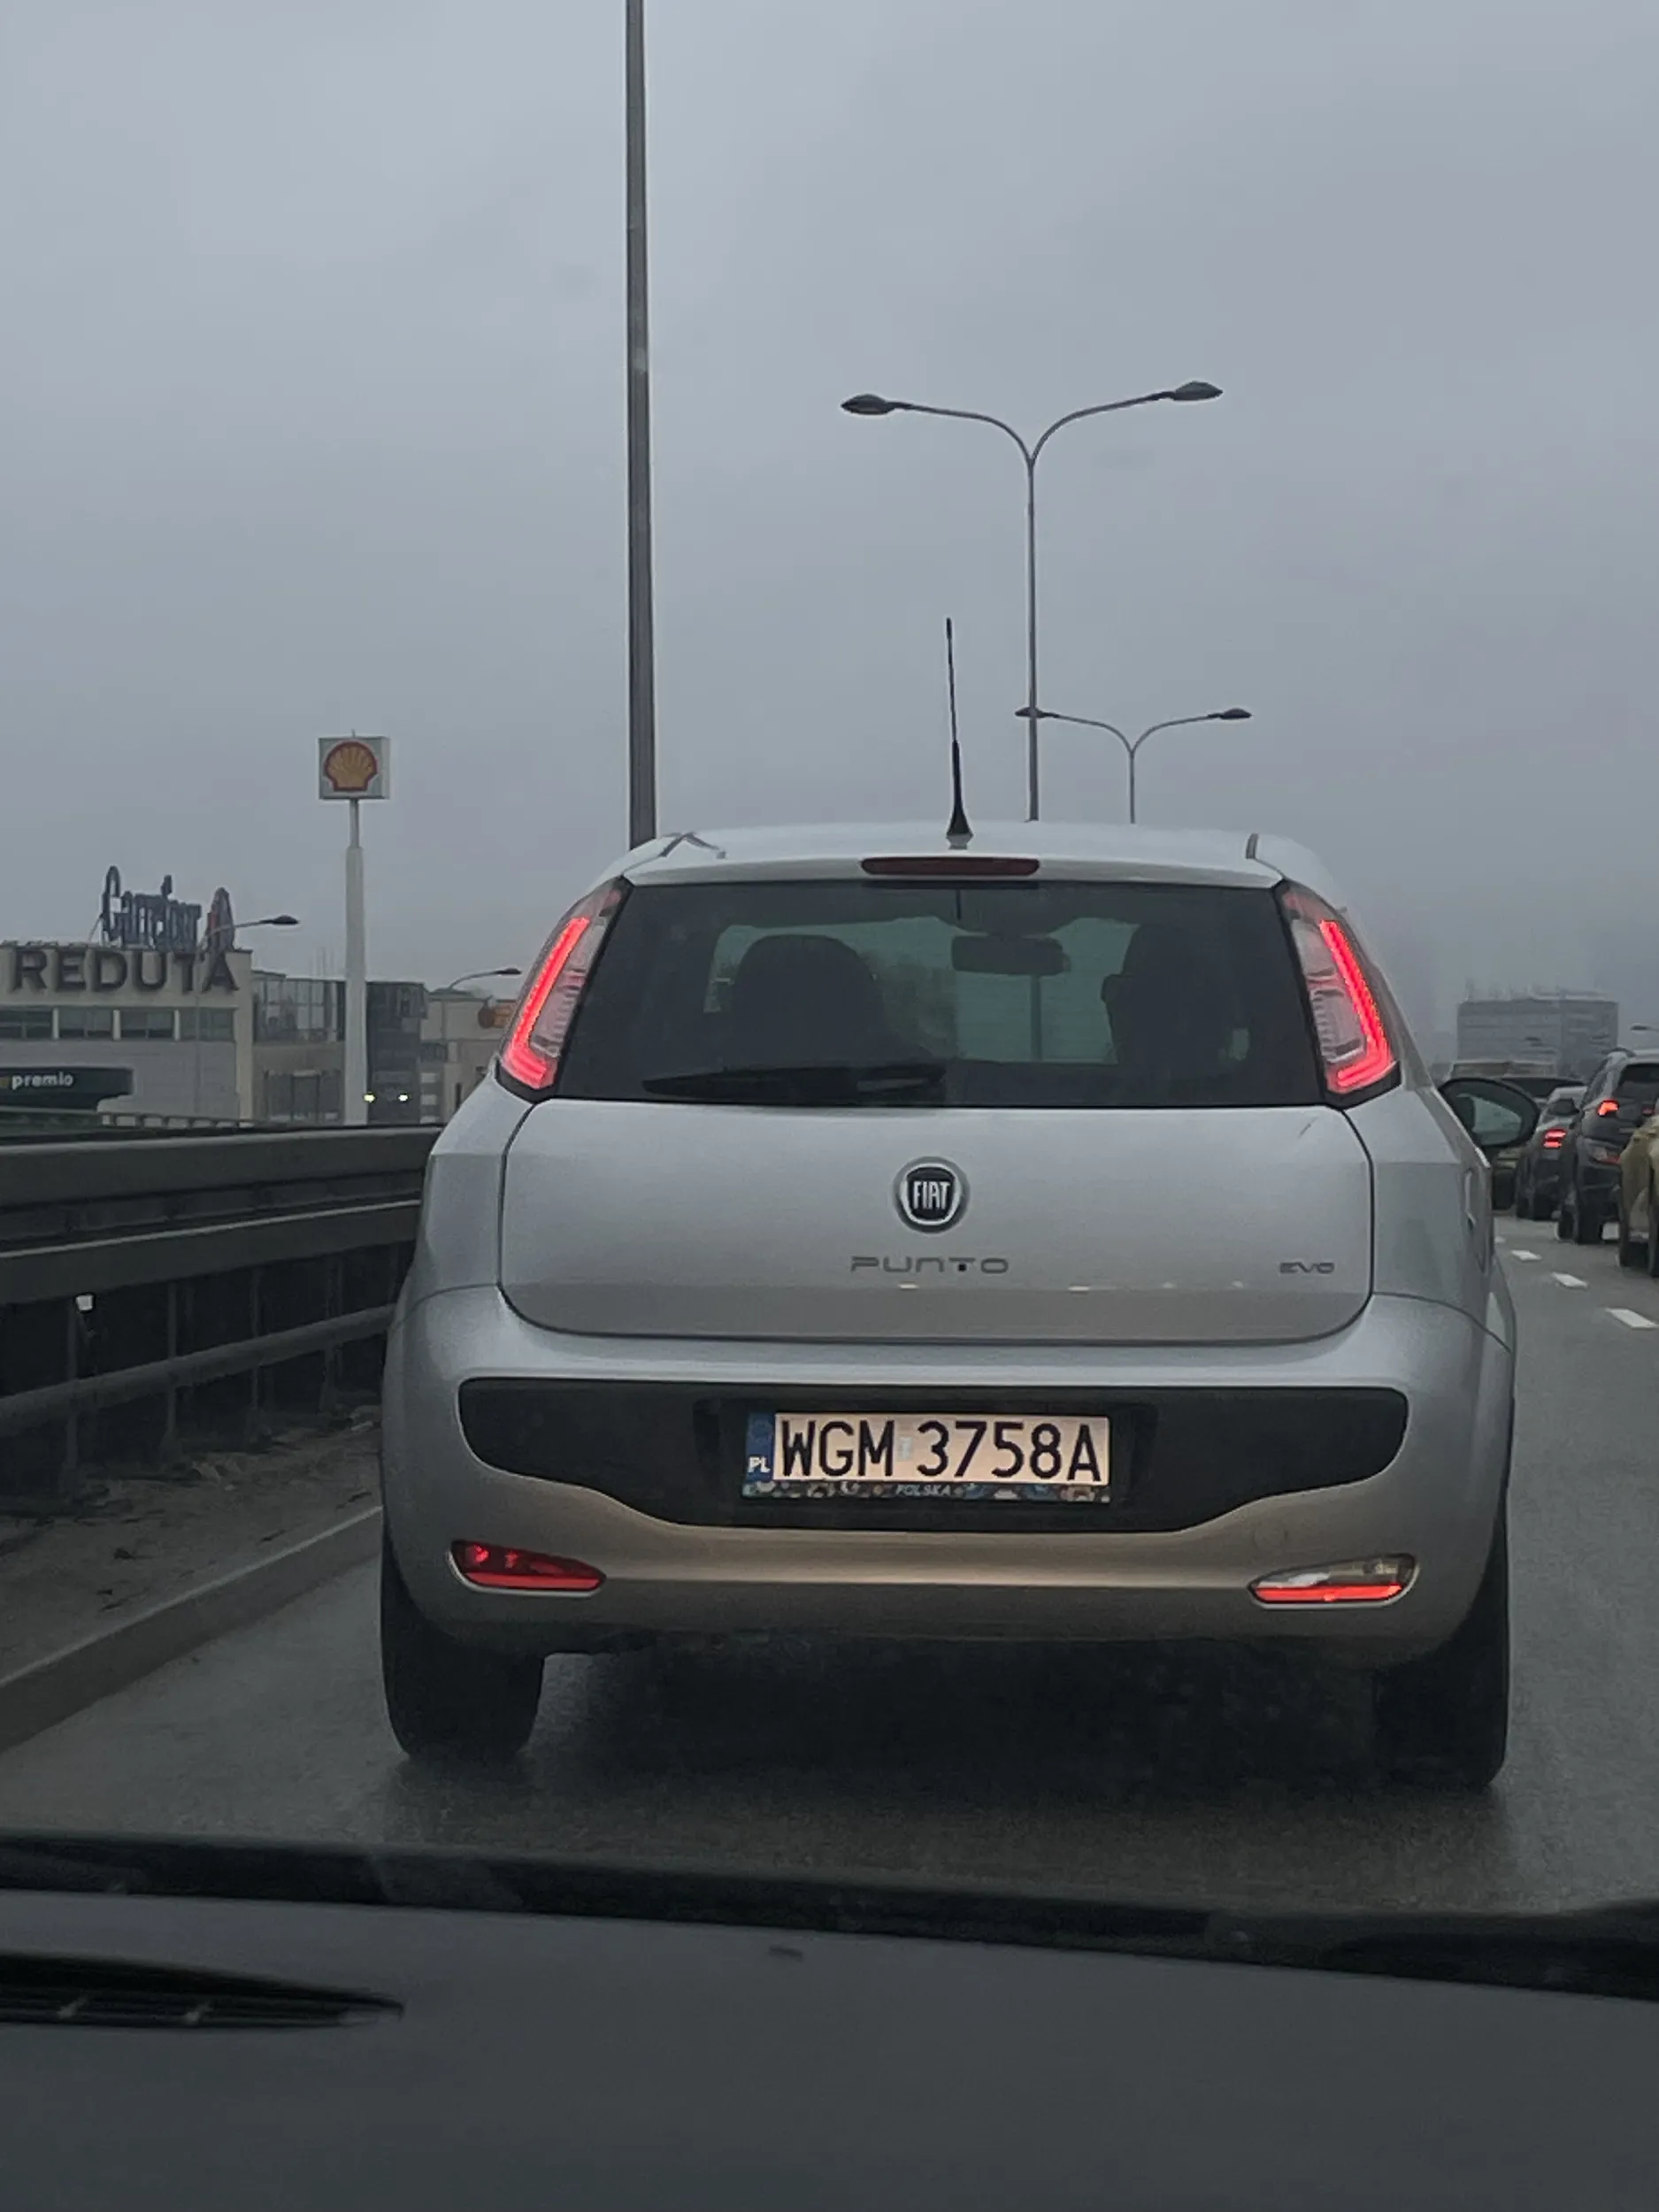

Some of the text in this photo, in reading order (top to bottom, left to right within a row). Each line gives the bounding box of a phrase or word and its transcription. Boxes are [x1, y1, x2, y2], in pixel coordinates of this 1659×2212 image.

[12, 946, 240, 992] REDUTA
[12, 1071, 74, 1090] premio
[912, 1181, 951, 1210] FIAT
[849, 1256, 1010, 1274] PUNTO
[1279, 1262, 1334, 1274] EVO
[781, 1419, 1102, 1482] WGM 3758A
[748, 1456, 771, 1473] PL
